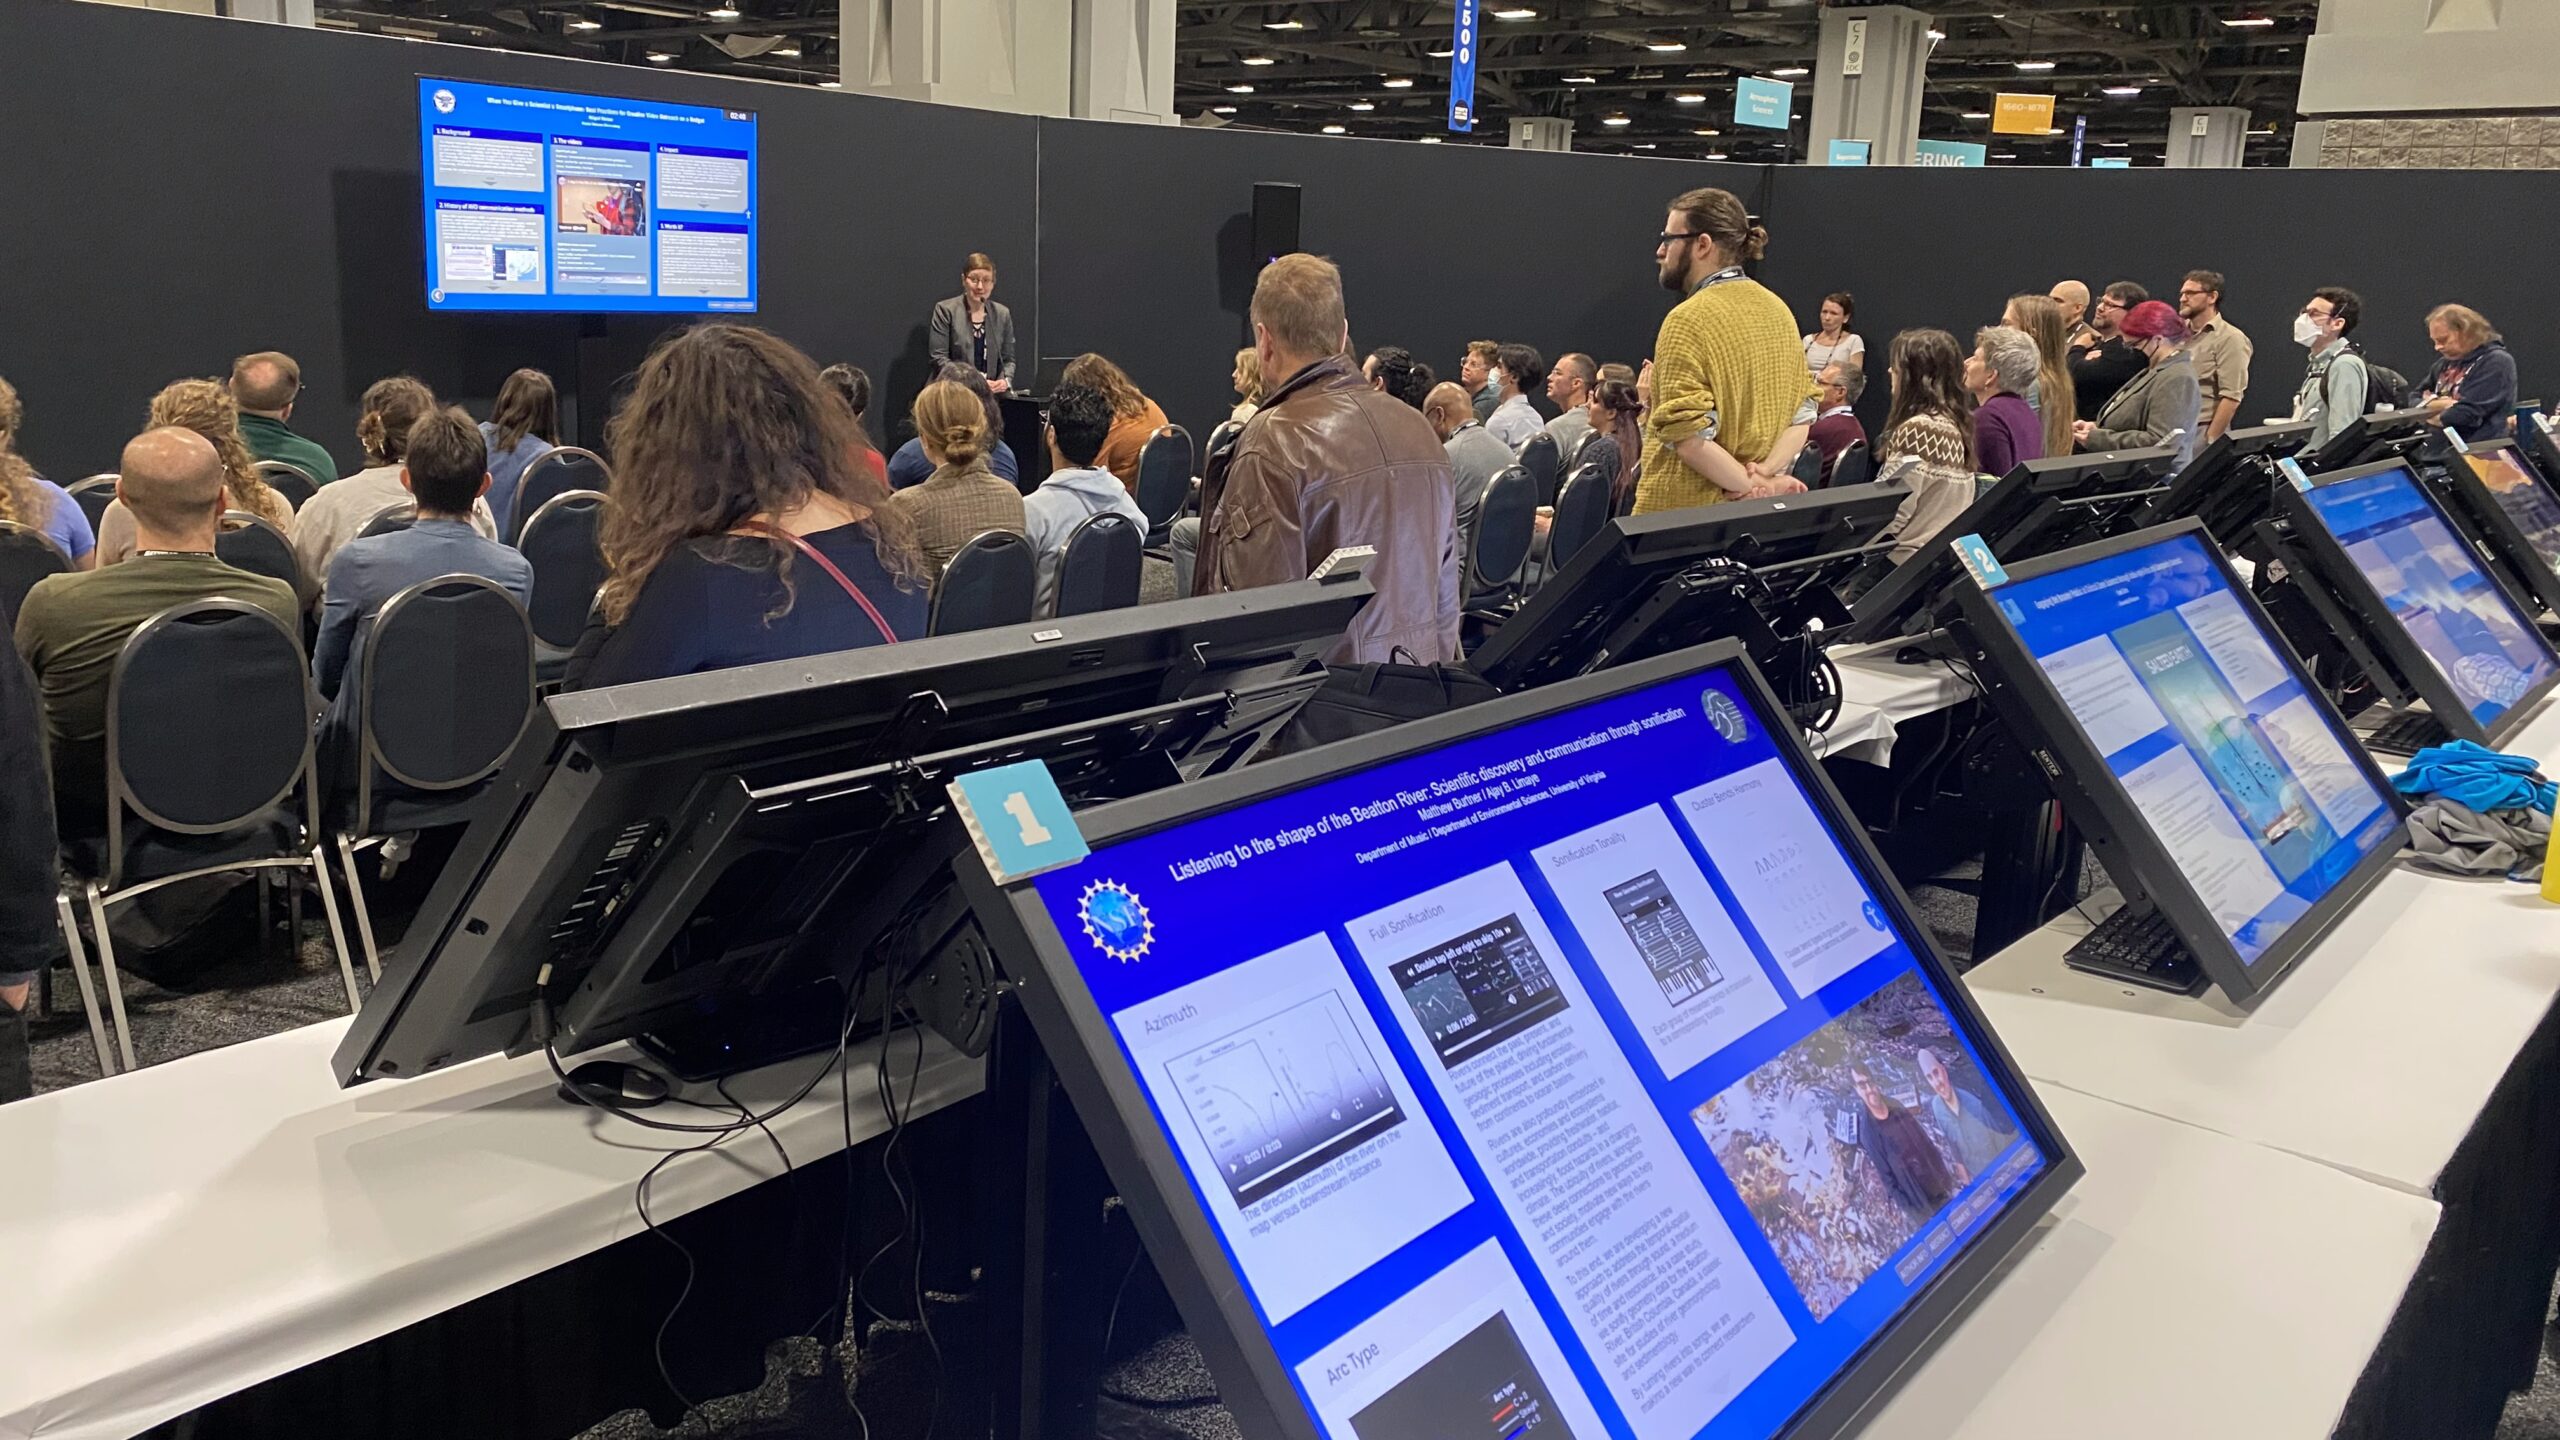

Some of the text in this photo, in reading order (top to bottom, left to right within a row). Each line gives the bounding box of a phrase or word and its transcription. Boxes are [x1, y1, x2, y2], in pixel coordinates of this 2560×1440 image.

[1973, 547, 1996, 574] 2
[1169, 708, 1686, 881] Listening to the shape of the Beatton River: Scientific discovery and communication through sonification
[1355, 841, 1400, 864] Department
[1398, 838, 1408, 848] of
[1405, 831, 1429, 846] Music
[1431, 816, 1472, 837] Department
[1470, 812, 1479, 823] of
[1477, 798, 1523, 820] Environmental
[1520, 791, 1552, 806] Sciences,
[1548, 780, 1580, 796] University
[1577, 776, 1586, 786] of
[1583, 771, 1607, 784] Virginia
[1417, 774, 1540, 821] Matthew Burtner / Ajay B. Limaye
[1003, 792, 1052, 846] 1
[1551, 832, 1627, 868] Sonification Tonality
[1091, 906, 1137, 940] NSF
[1368, 905, 1445, 941] Full Sonification
[1414, 928, 1505, 973] Double tap left or right to skip 10s
[1144, 1004, 1198, 1035] Azimuth
[1447, 1017, 1561, 1081] Rivers connect the past, present, and
[1454, 1025, 1574, 1094] future of the planet, driving fundamental
[1241, 1130, 1401, 1222] The direction (azimuth) of the river on the
[1249, 1158, 1382, 1237] map versus downstream distance
[1327, 1343, 1380, 1386] Arc Type
